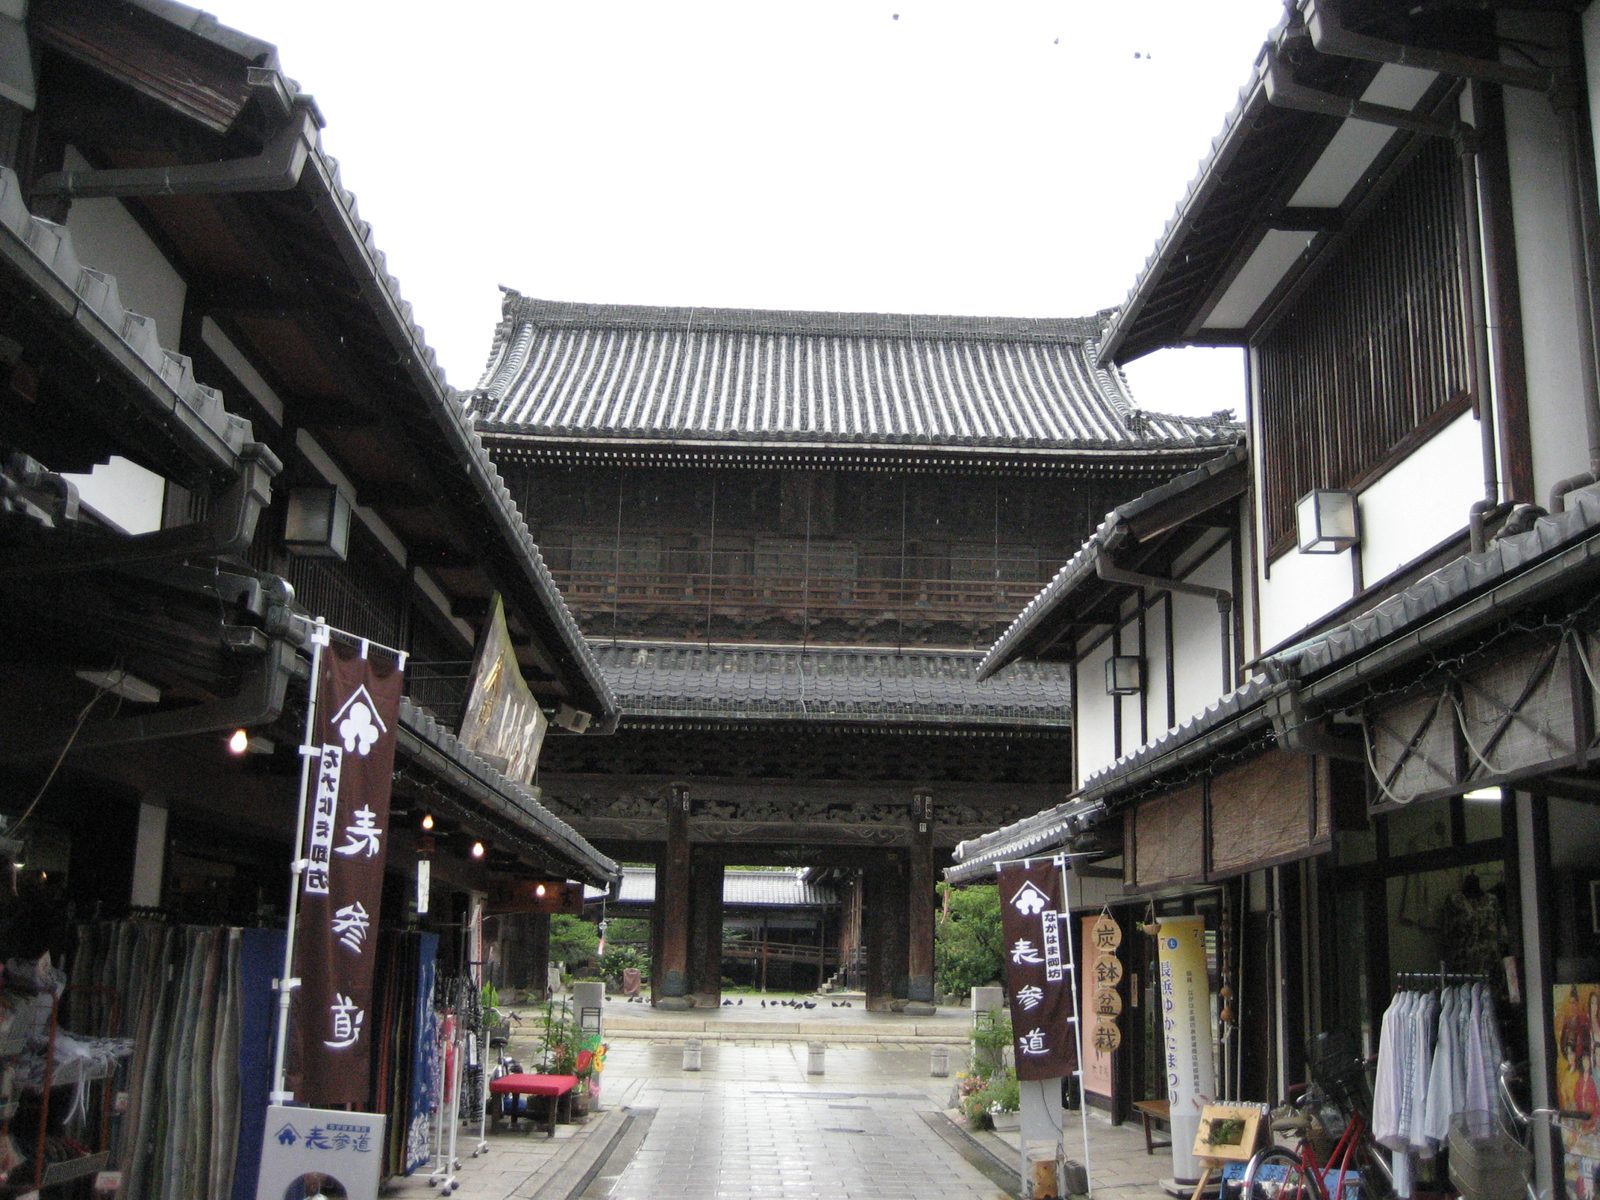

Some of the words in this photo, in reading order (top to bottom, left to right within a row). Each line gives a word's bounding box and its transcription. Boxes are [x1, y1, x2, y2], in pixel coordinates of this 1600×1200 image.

[1010, 938, 1050, 1054] 表参道
[1044, 912, 1062, 979] ながはま御坊
[1095, 924, 1119, 1049] 炭鉢盆栽
[1161, 961, 1178, 1105] 長浜ゆかたまつり
[304, 1125, 372, 1152] 表参道
